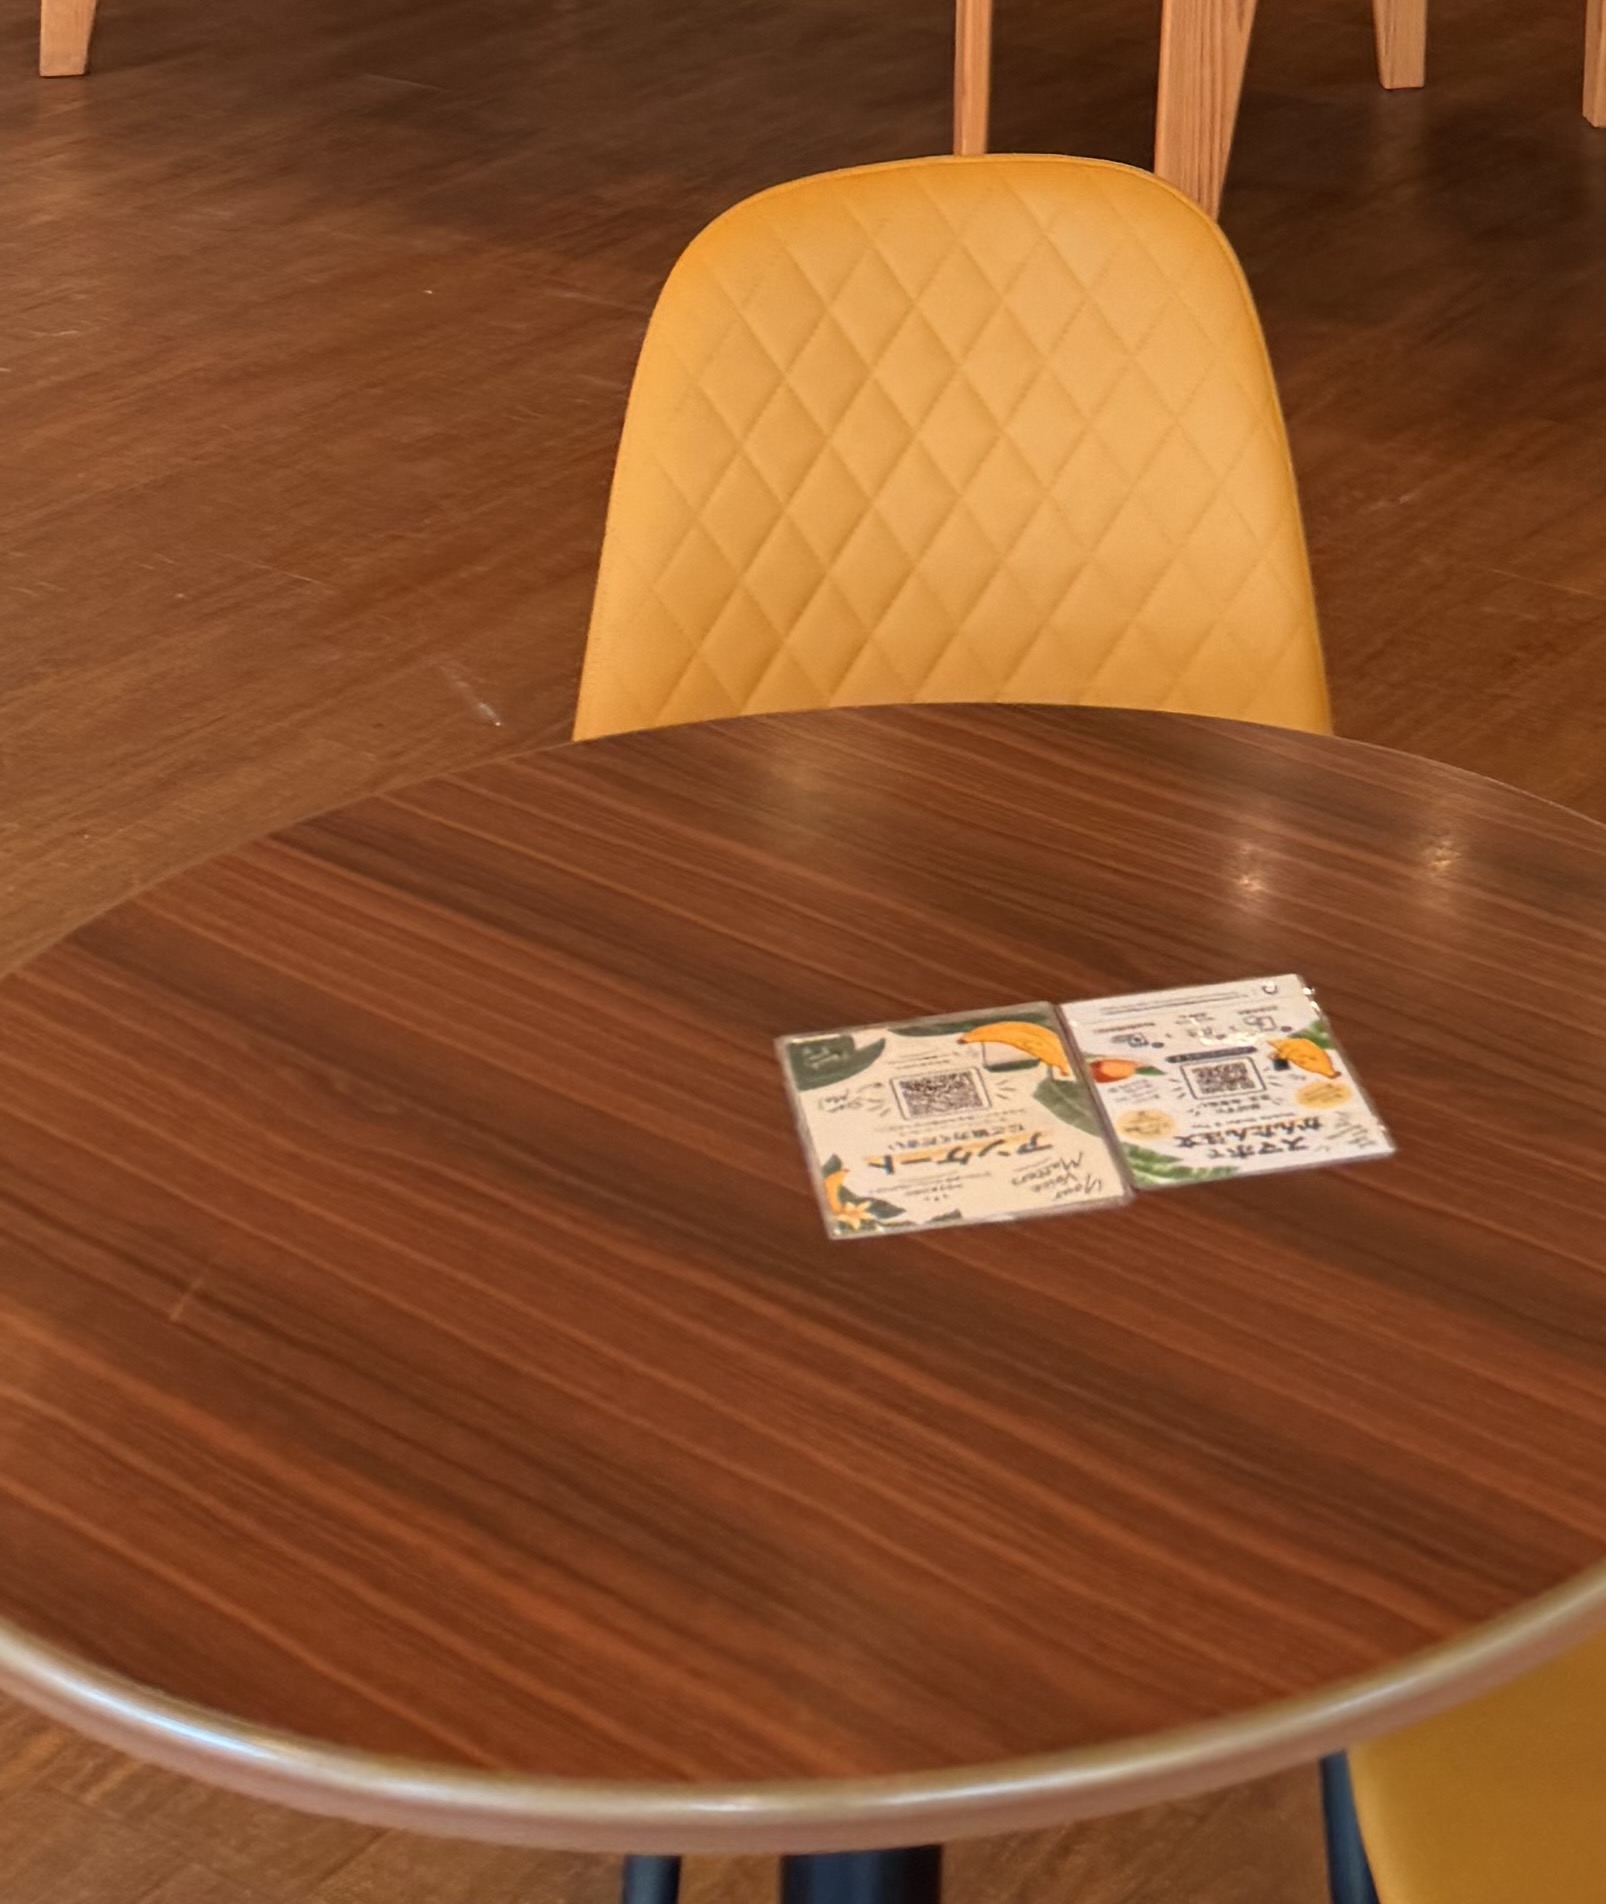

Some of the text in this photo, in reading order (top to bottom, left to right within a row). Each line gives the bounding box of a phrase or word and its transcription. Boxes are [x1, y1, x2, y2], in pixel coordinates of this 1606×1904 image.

[1173, 1117, 1323, 1149] かんたん注文
[1206, 1135, 1308, 1160] スマホで
[867, 1132, 1054, 1176] アンケート
